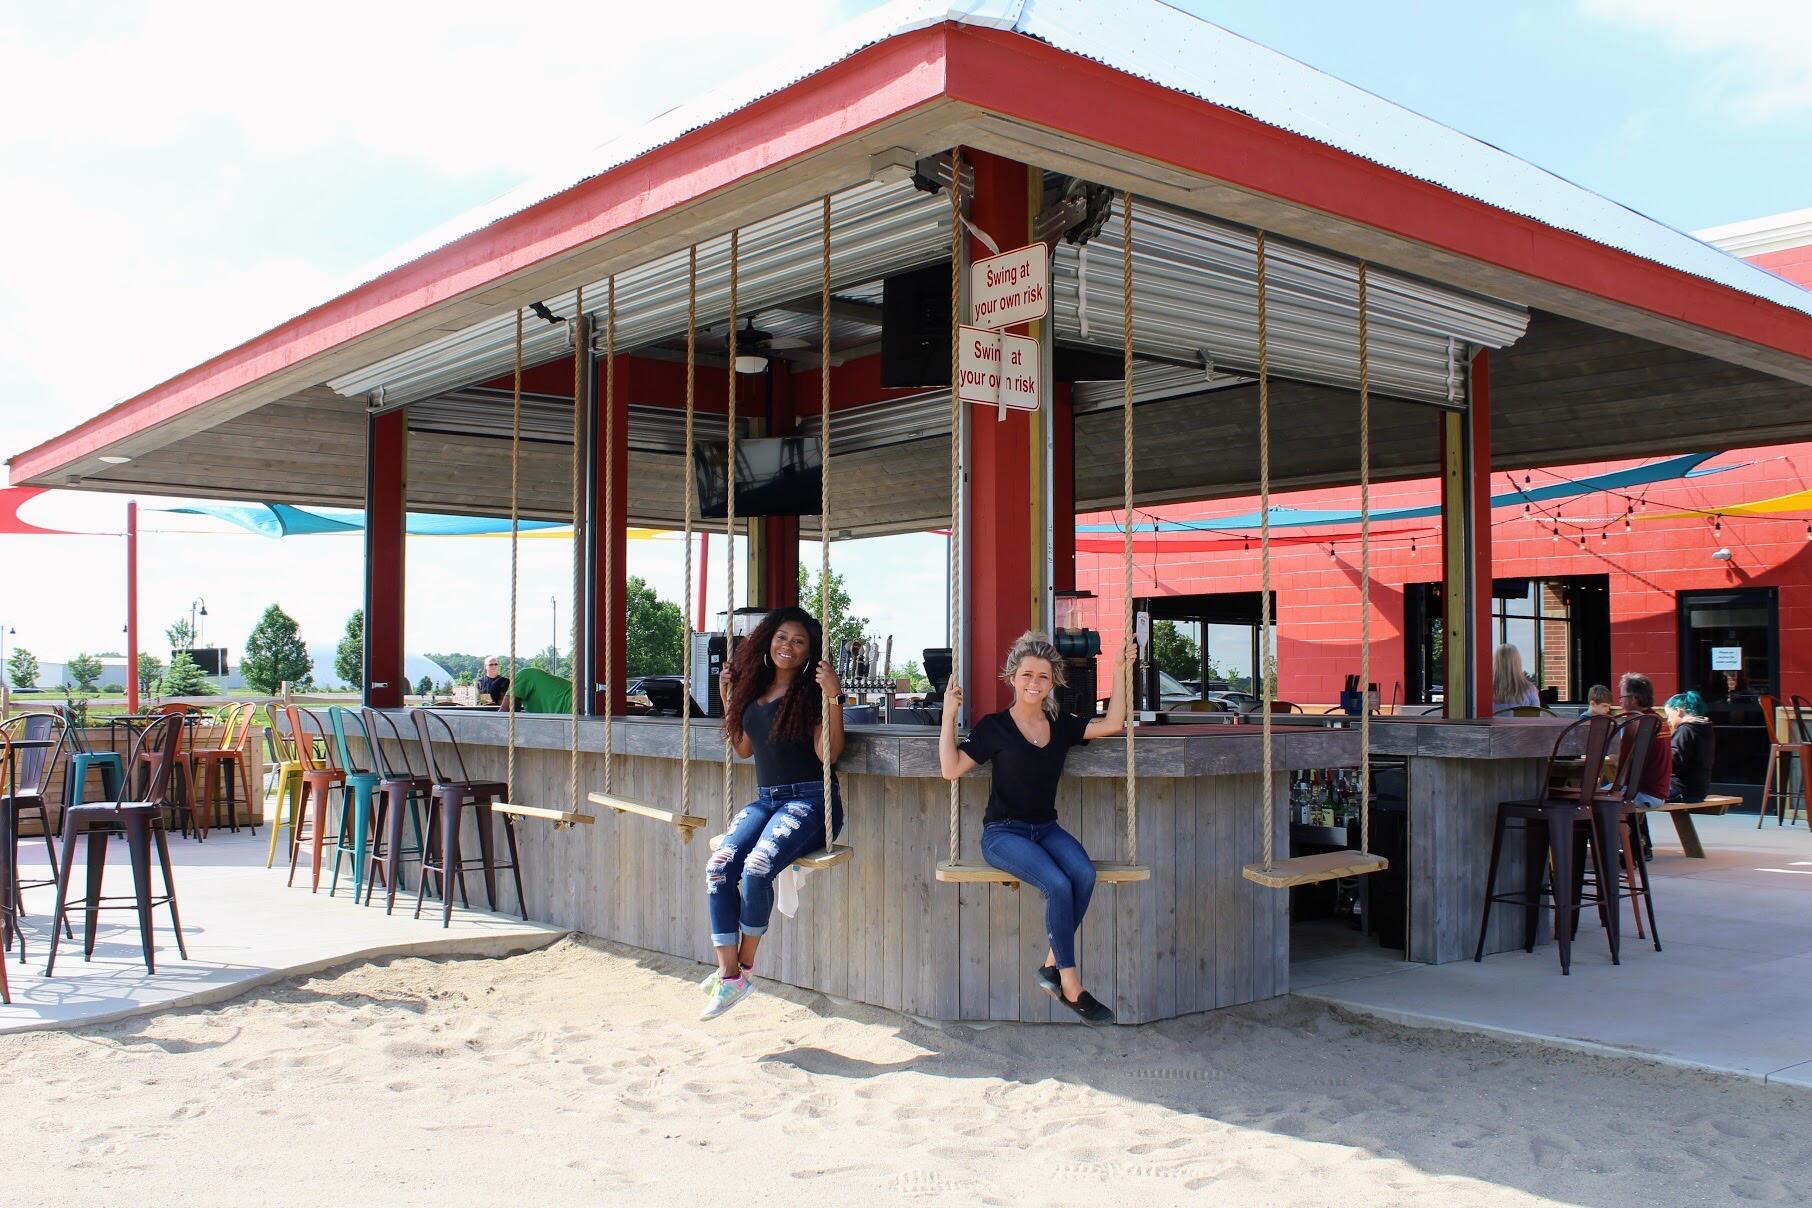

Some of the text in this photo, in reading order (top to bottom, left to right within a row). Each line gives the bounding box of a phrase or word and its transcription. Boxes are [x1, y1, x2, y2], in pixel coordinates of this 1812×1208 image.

[987, 260, 1030, 287] Swing at
[975, 283, 1043, 322] your own risk
[974, 340, 1022, 365] Swin at
[960, 369, 986, 388] your
[1015, 374, 1035, 394] risk
